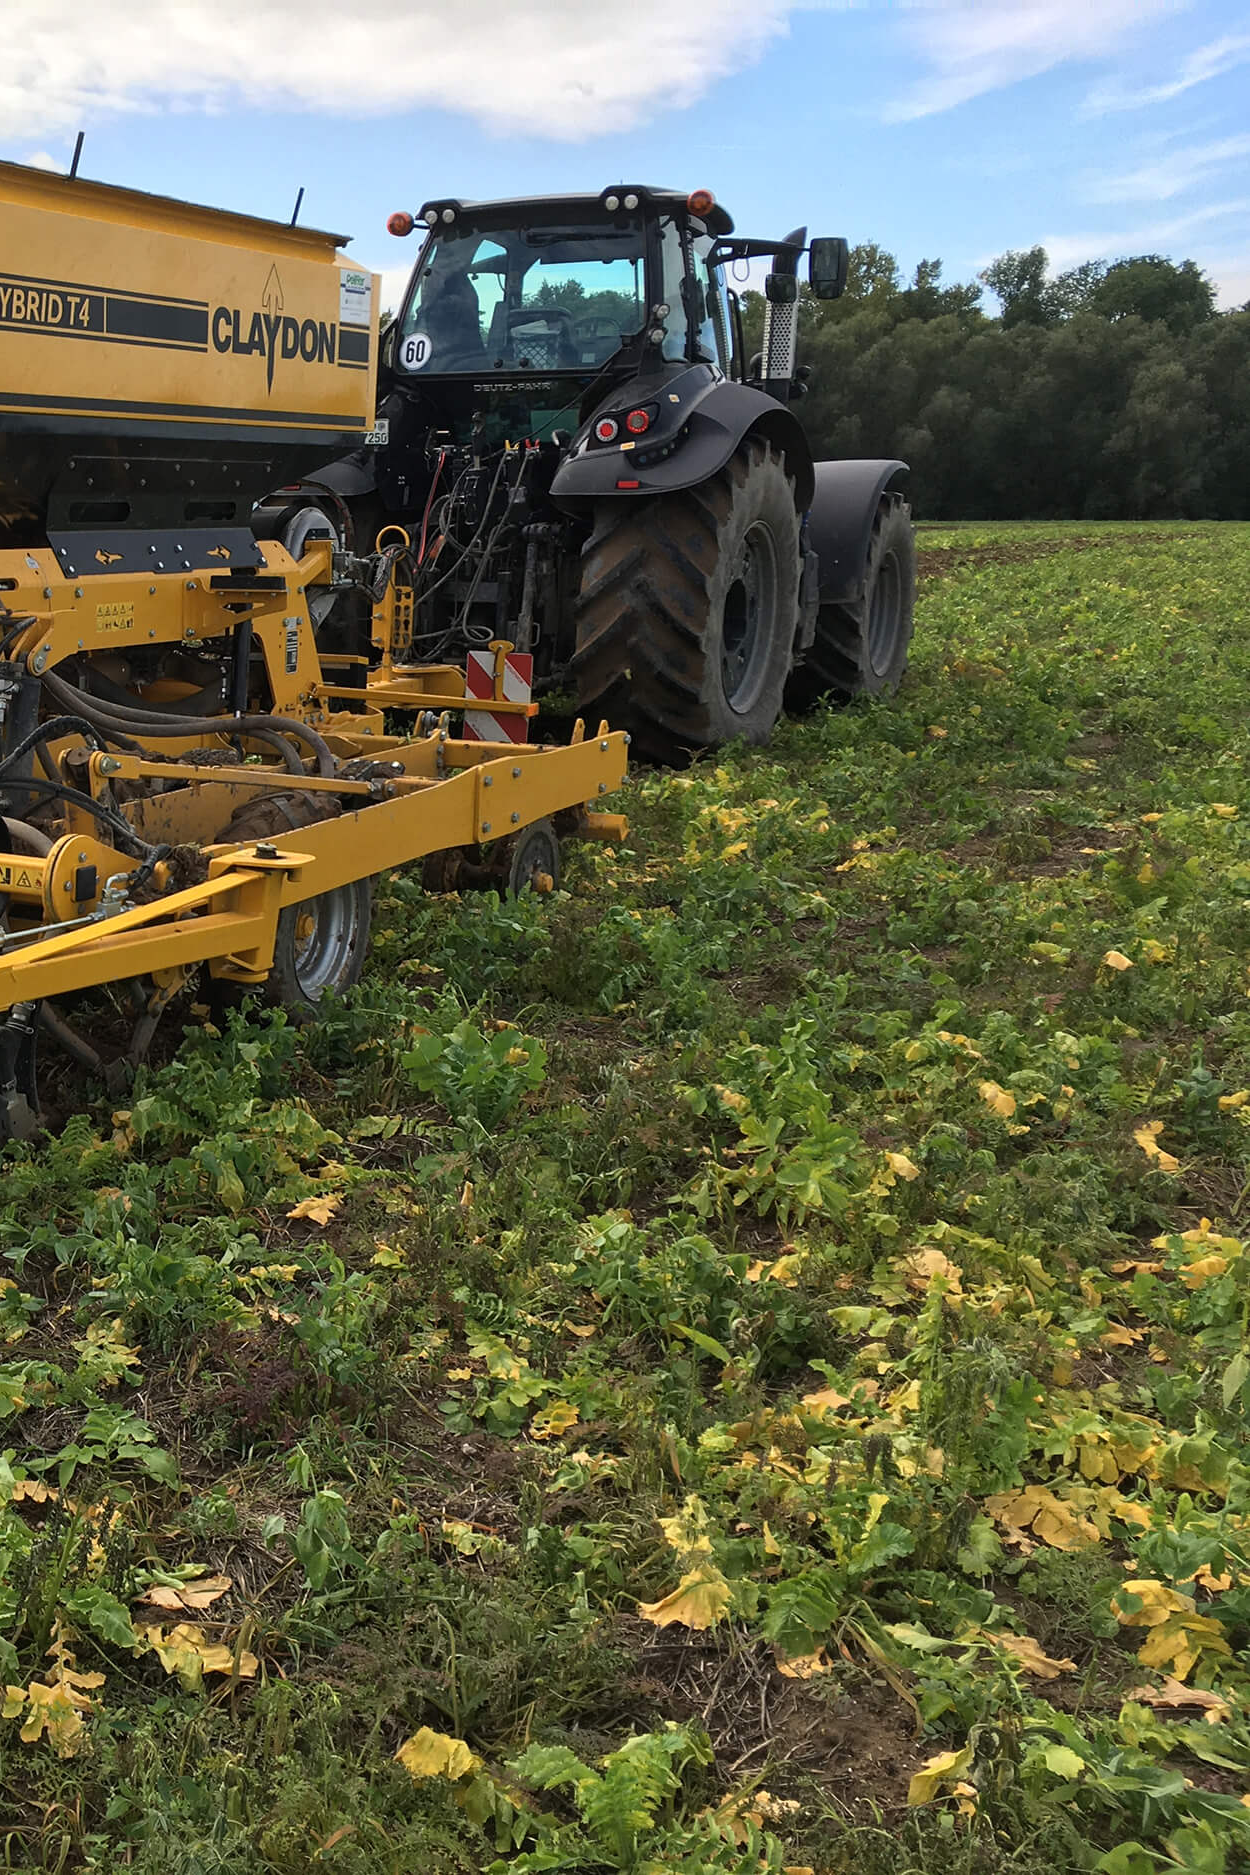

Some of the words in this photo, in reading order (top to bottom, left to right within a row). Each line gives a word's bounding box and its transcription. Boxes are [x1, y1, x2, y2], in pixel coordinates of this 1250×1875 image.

[67, 295, 90, 327] T4
[212, 306, 336, 396] CLAYDON
[406, 340, 425, 363] 60
[472, 382, 552, 393] DEUTZ-FAHR
